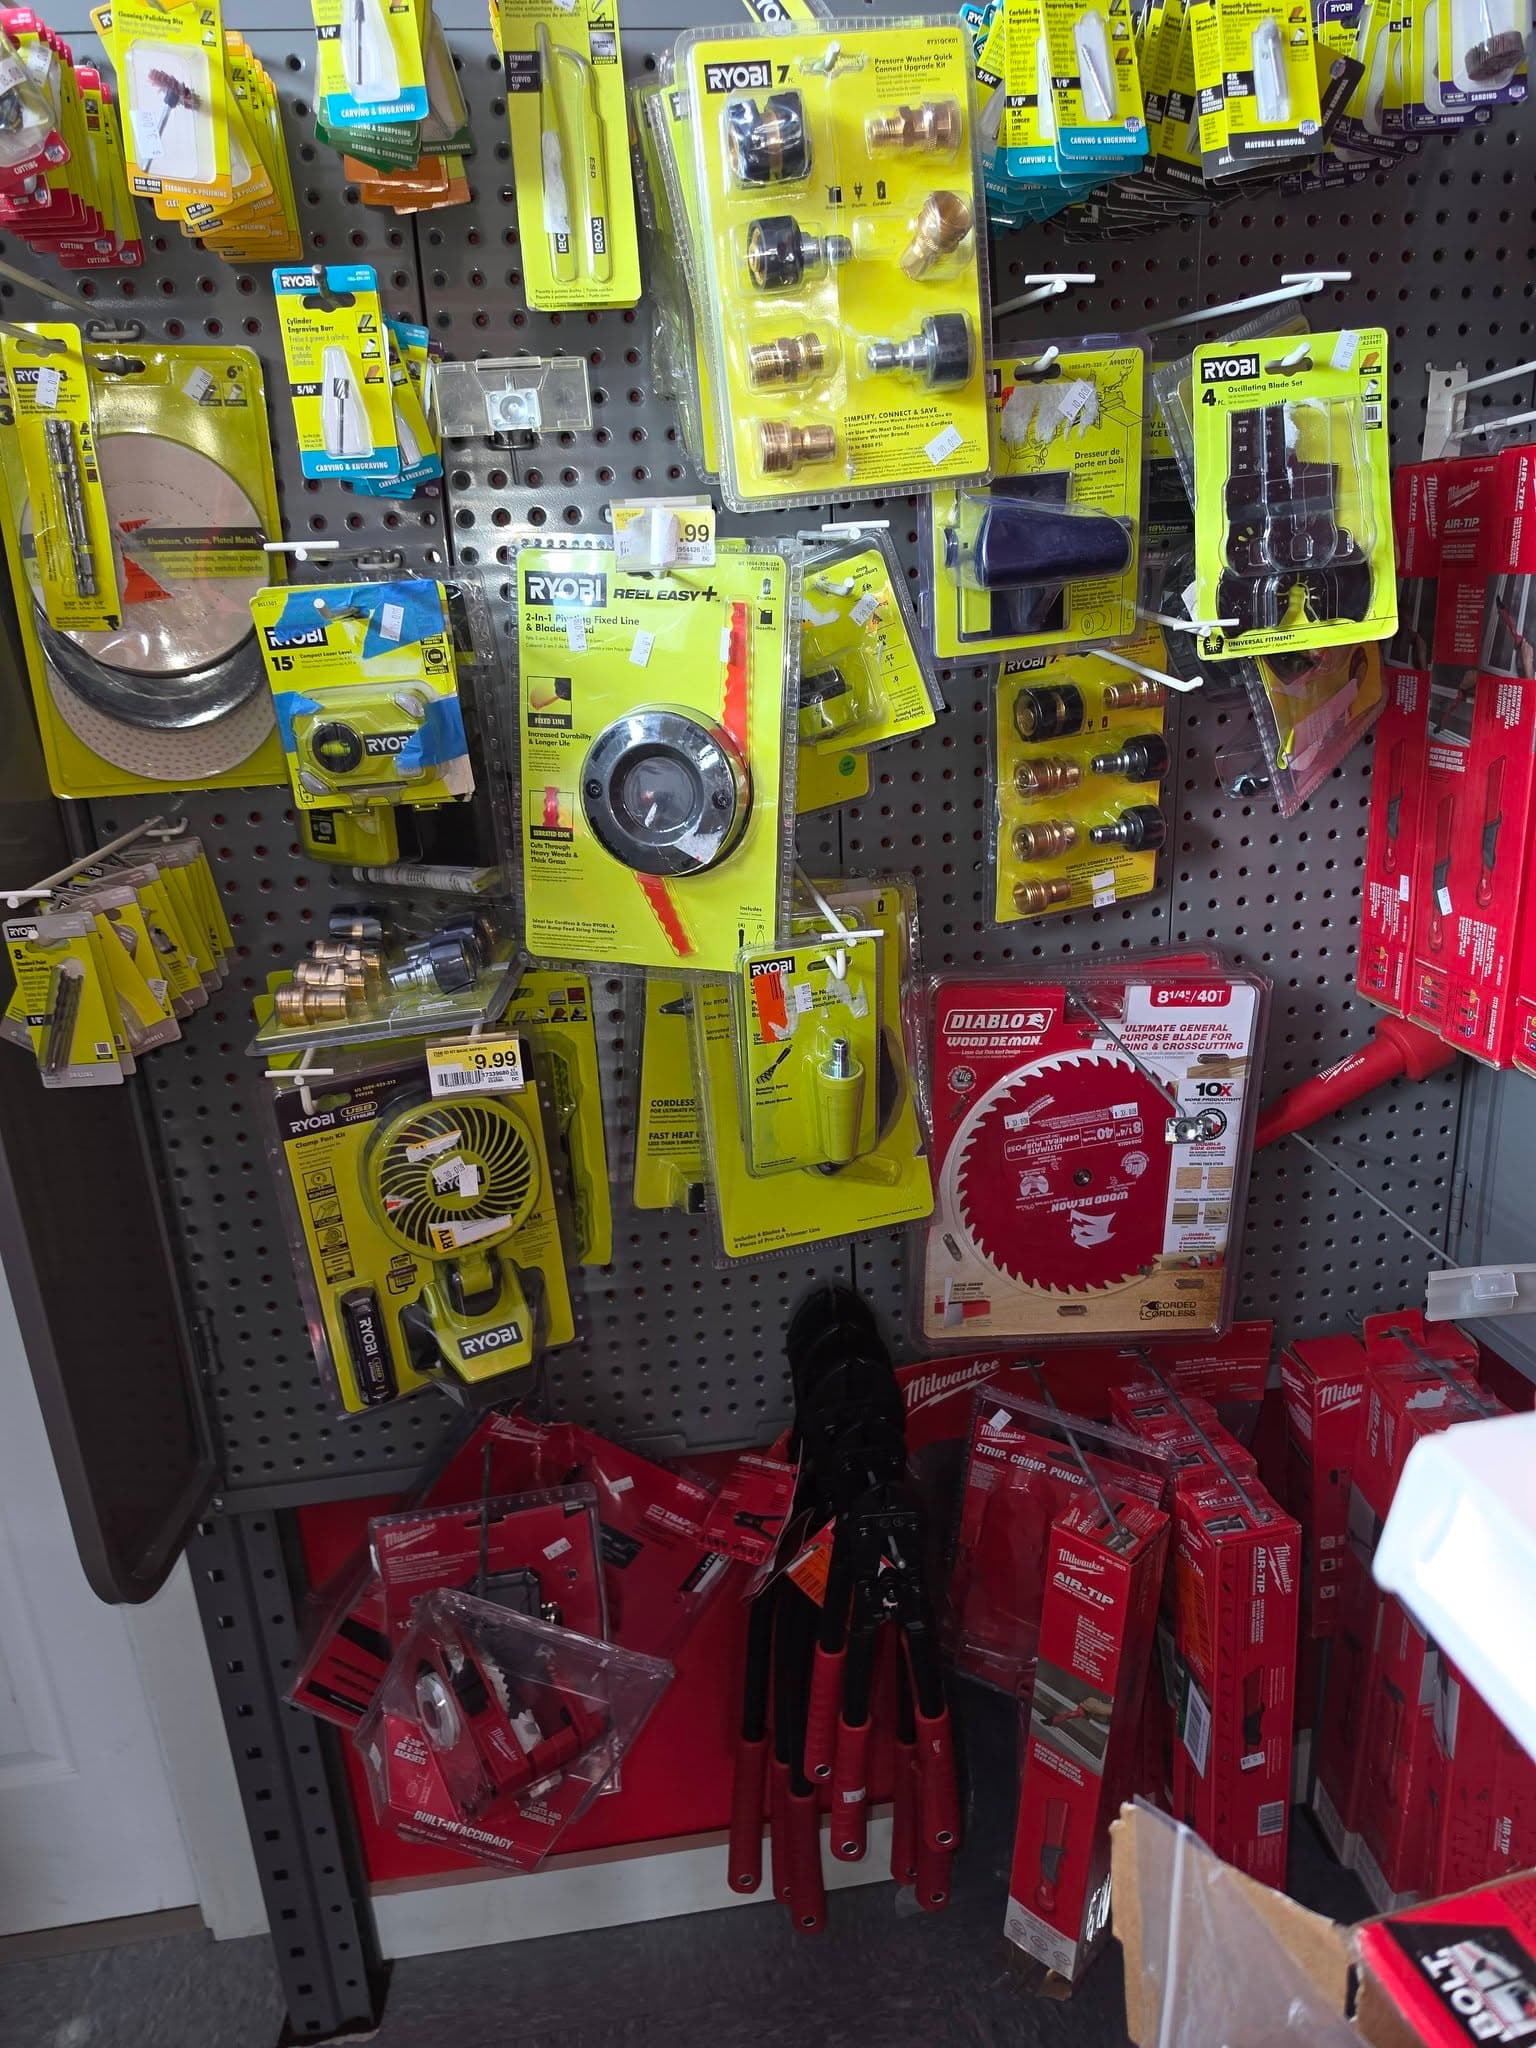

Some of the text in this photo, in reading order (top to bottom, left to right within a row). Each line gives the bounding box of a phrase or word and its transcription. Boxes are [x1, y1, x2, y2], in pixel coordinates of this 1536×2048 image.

[1331, 4, 1353, 12] RYOBI
[509, 54, 533, 62] STRAIGHT
[874, 53, 953, 65] Pressure Washer Quick
[875, 65, 902, 73] Connect
[904, 63, 934, 72] Upgrade
[707, 64, 789, 89] RYOBI 7
[1201, 88, 1213, 97] 4X
[1471, 93, 1497, 102] SANDING
[340, 103, 416, 119] CARVING & ENGRAVING
[1440, 116, 1465, 124] SANDING
[1070, 136, 1096, 145] CARVING
[1103, 136, 1137, 144] ENGRAVING
[1244, 138, 1305, 149] MATERIAL REMOVAL
[1019, 156, 1047, 164] CARVING
[592, 218, 604, 253] RYOBI
[281, 275, 316, 288] RYOBI
[287, 317, 312, 325] Cylinder
[288, 325, 319, 334] Engraving
[1203, 358, 1256, 379] RYOBI
[297, 385, 317, 396] 5/16"
[1228, 382, 1266, 393] Oscillating
[1268, 381, 1290, 389] Blade
[1202, 389, 1217, 406] 4
[844, 413, 878, 423] SIMPLIFY,
[879, 409, 912, 419] CONNECT
[1074, 450, 1109, 460] Dresseur
[315, 461, 388, 472] CARVING & ENGRAVING
[1074, 460, 1098, 470] porte
[1108, 456, 1125, 465] bois
[1518, 457, 1529, 511] AIR-TIP
[1444, 517, 1480, 528] AIR-TIP
[680, 524, 709, 542] .99
[528, 577, 602, 602] RYOBI
[613, 589, 655, 601] REEL
[526, 613, 640, 626] 2-In-1 Fixed Line
[526, 624, 567, 633] & Bladed
[1228, 638, 1264, 647] UNIVERSAL
[300, 651, 322, 659] Compact
[271, 655, 295, 671] 15'
[1007, 656, 1046, 673] RYOBI
[534, 717, 565, 726] FIXED LINE
[528, 730, 592, 742] Increased Durability
[535, 738, 558, 748] Longer
[559, 739, 571, 747] Life
[544, 842, 571, 851] Through
[530, 850, 550, 858] Heavy
[551, 850, 572, 858] Weeds
[530, 857, 566, 865] Thick Grass
[14, 949, 23, 960] 8
[751, 959, 793, 976] RYOBI
[950, 1013, 1025, 1029] DIABLO
[1125, 1024, 1228, 1033] ULTIMATE GENERAL
[947, 1035, 1041, 1047] WOOD DEMON
[1120, 1033, 1233, 1041] PURPOSE BLADE FOR
[1162, 1042, 1244, 1050] CROSSCUTTING
[475, 1051, 516, 1070] 9.99
[651, 1098, 695, 1107] CORDLESS
[346, 1104, 373, 1115] USB
[289, 1113, 336, 1133] RYOBI
[648, 1131, 694, 1140] FAST HEAT
[1096, 1126, 1114, 1140] 40
[296, 1139, 318, 1149] Clamp
[1006, 1134, 1080, 1153] GENERAL PURPOSE
[1027, 1143, 1063, 1155] ULTIMATE
[1051, 1191, 1129, 1213] WOOD DEMON
[1157, 1301, 1197, 1309] CORDED
[1144, 1309, 1196, 1317] CORDLESS
[359, 1317, 379, 1356] RYOBI
[461, 1325, 518, 1356] RYOBI
[904, 1360, 1000, 1406] Milwaukee
[976, 1442, 1007, 1460] STRIP.
[1010, 1454, 1047, 1472] CRIMP.
[1057, 1548, 1104, 1572] Milwaukee
[1256, 1546, 1266, 1593] AIR-TIP
[1273, 1543, 1294, 1595] Milwaukee
[1053, 1571, 1115, 1605] AIR-TIP
[413, 1810, 514, 1850] BUILT-IN ACCURACY
[1499, 1817, 1513, 1855] AIR-TIP
